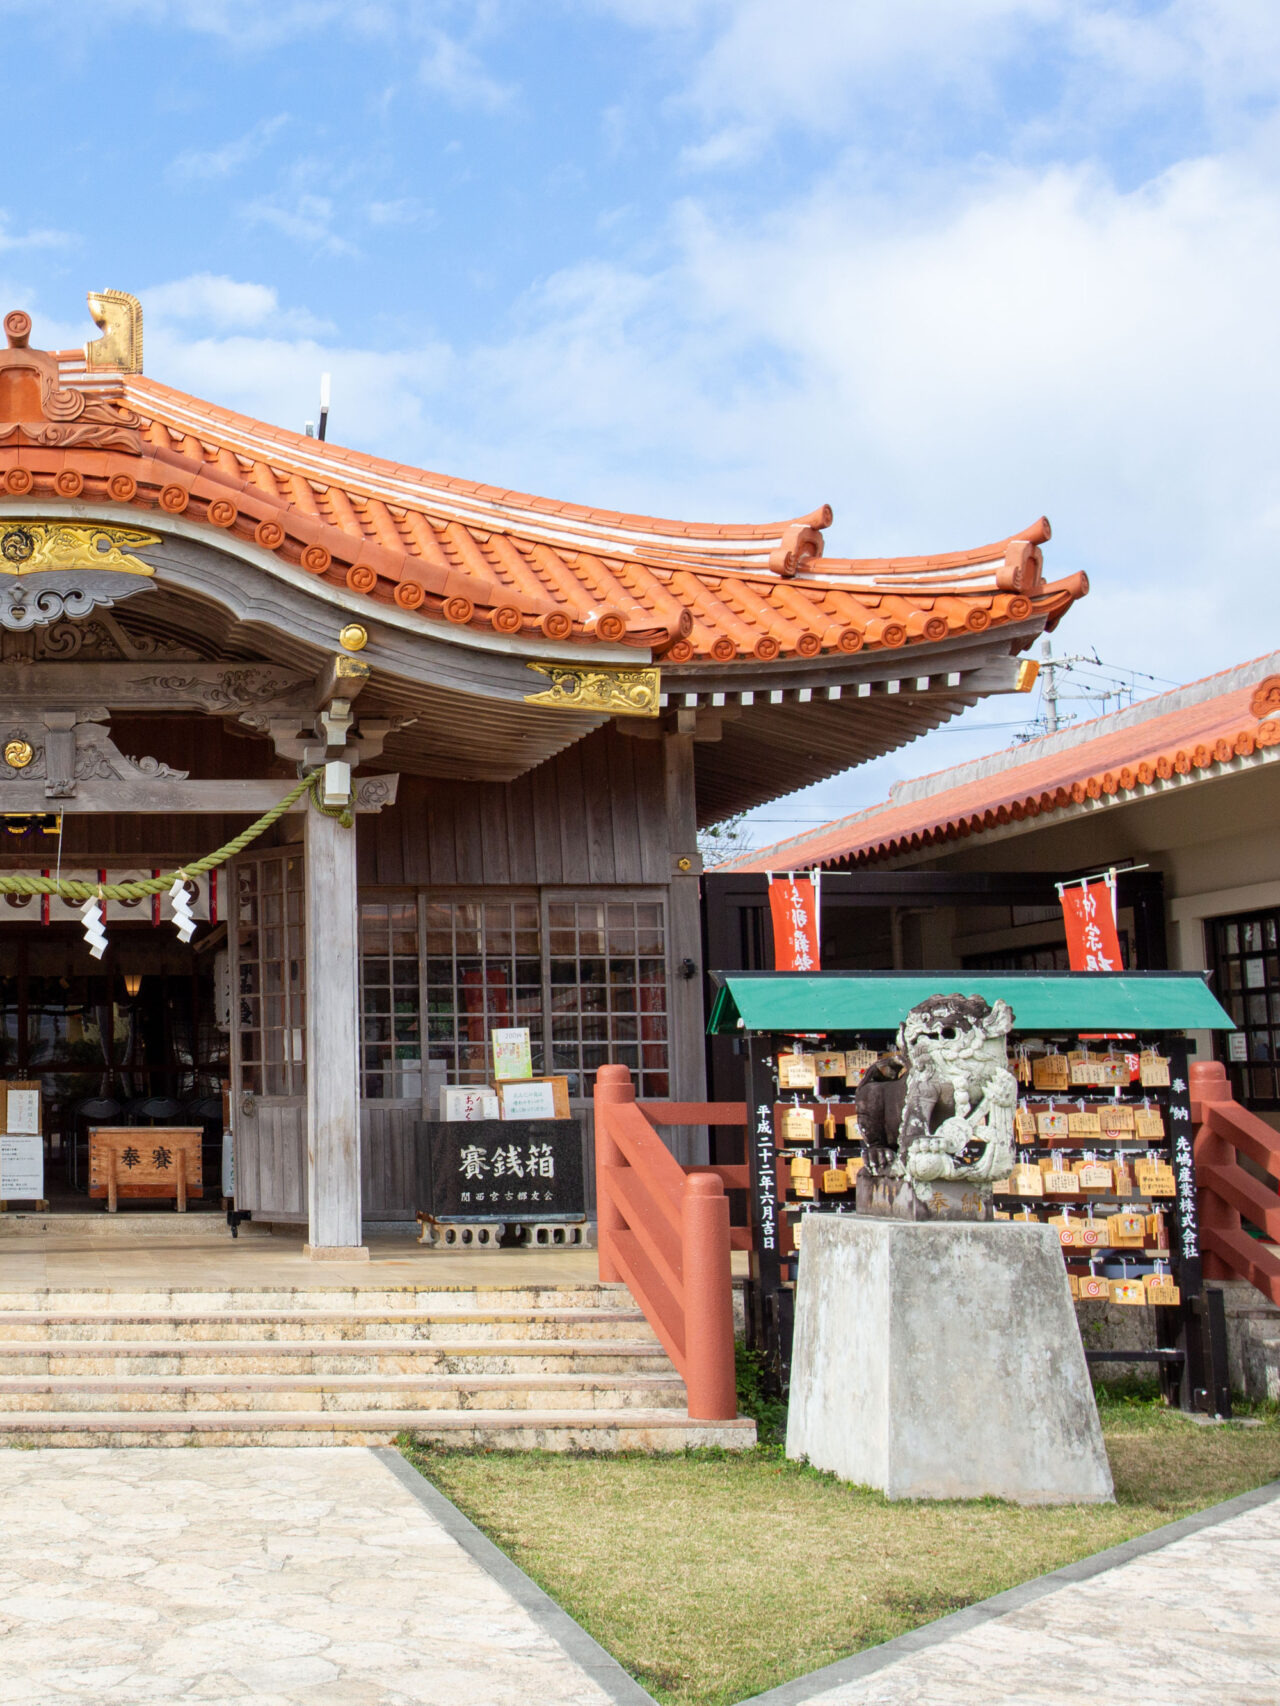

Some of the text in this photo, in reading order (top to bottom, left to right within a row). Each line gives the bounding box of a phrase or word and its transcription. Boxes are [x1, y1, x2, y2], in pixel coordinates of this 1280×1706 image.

[465, 1095, 474, 1120] おみく
[459, 1143, 555, 1180] 賽銭箱
[756, 1105, 775, 1250] 平成二十二年六月吉日
[1171, 1078, 1199, 1260] 奉納 先嶋産業株式会社
[928, 1190, 983, 1213] 奉納
